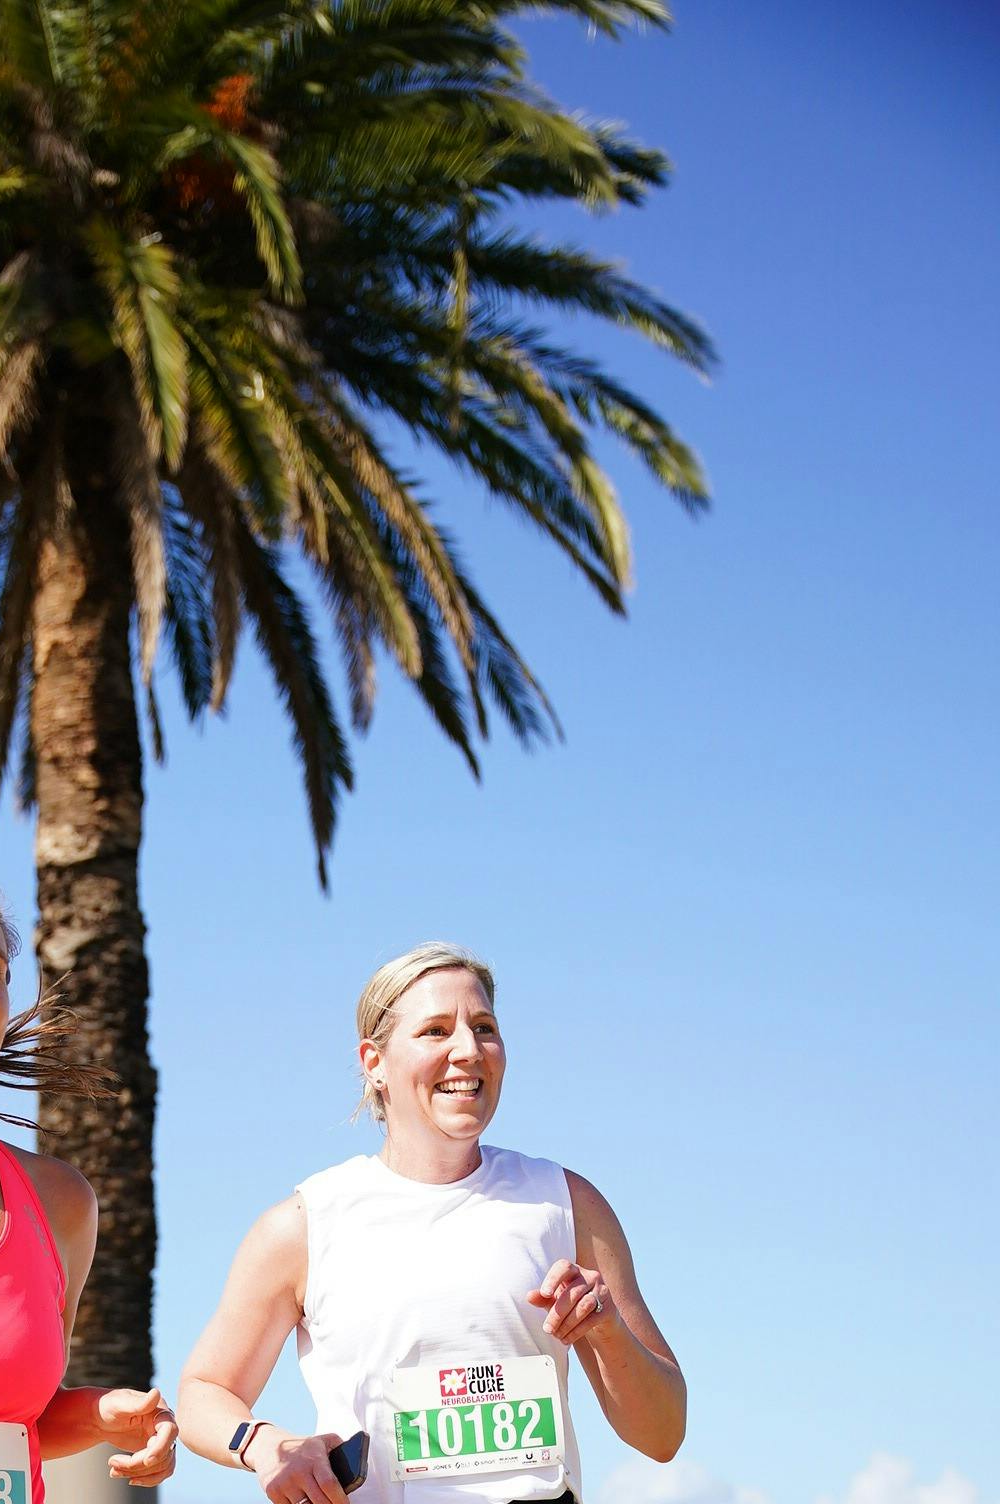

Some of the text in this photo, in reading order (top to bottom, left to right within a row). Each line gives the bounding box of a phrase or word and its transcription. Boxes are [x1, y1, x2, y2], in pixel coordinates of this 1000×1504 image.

[467, 1364, 502, 1380] RUN2
[469, 1378, 504, 1394] CURE
[441, 1393, 506, 1406] NEUROBLASTOMA
[409, 1400, 543, 1458] 10182
